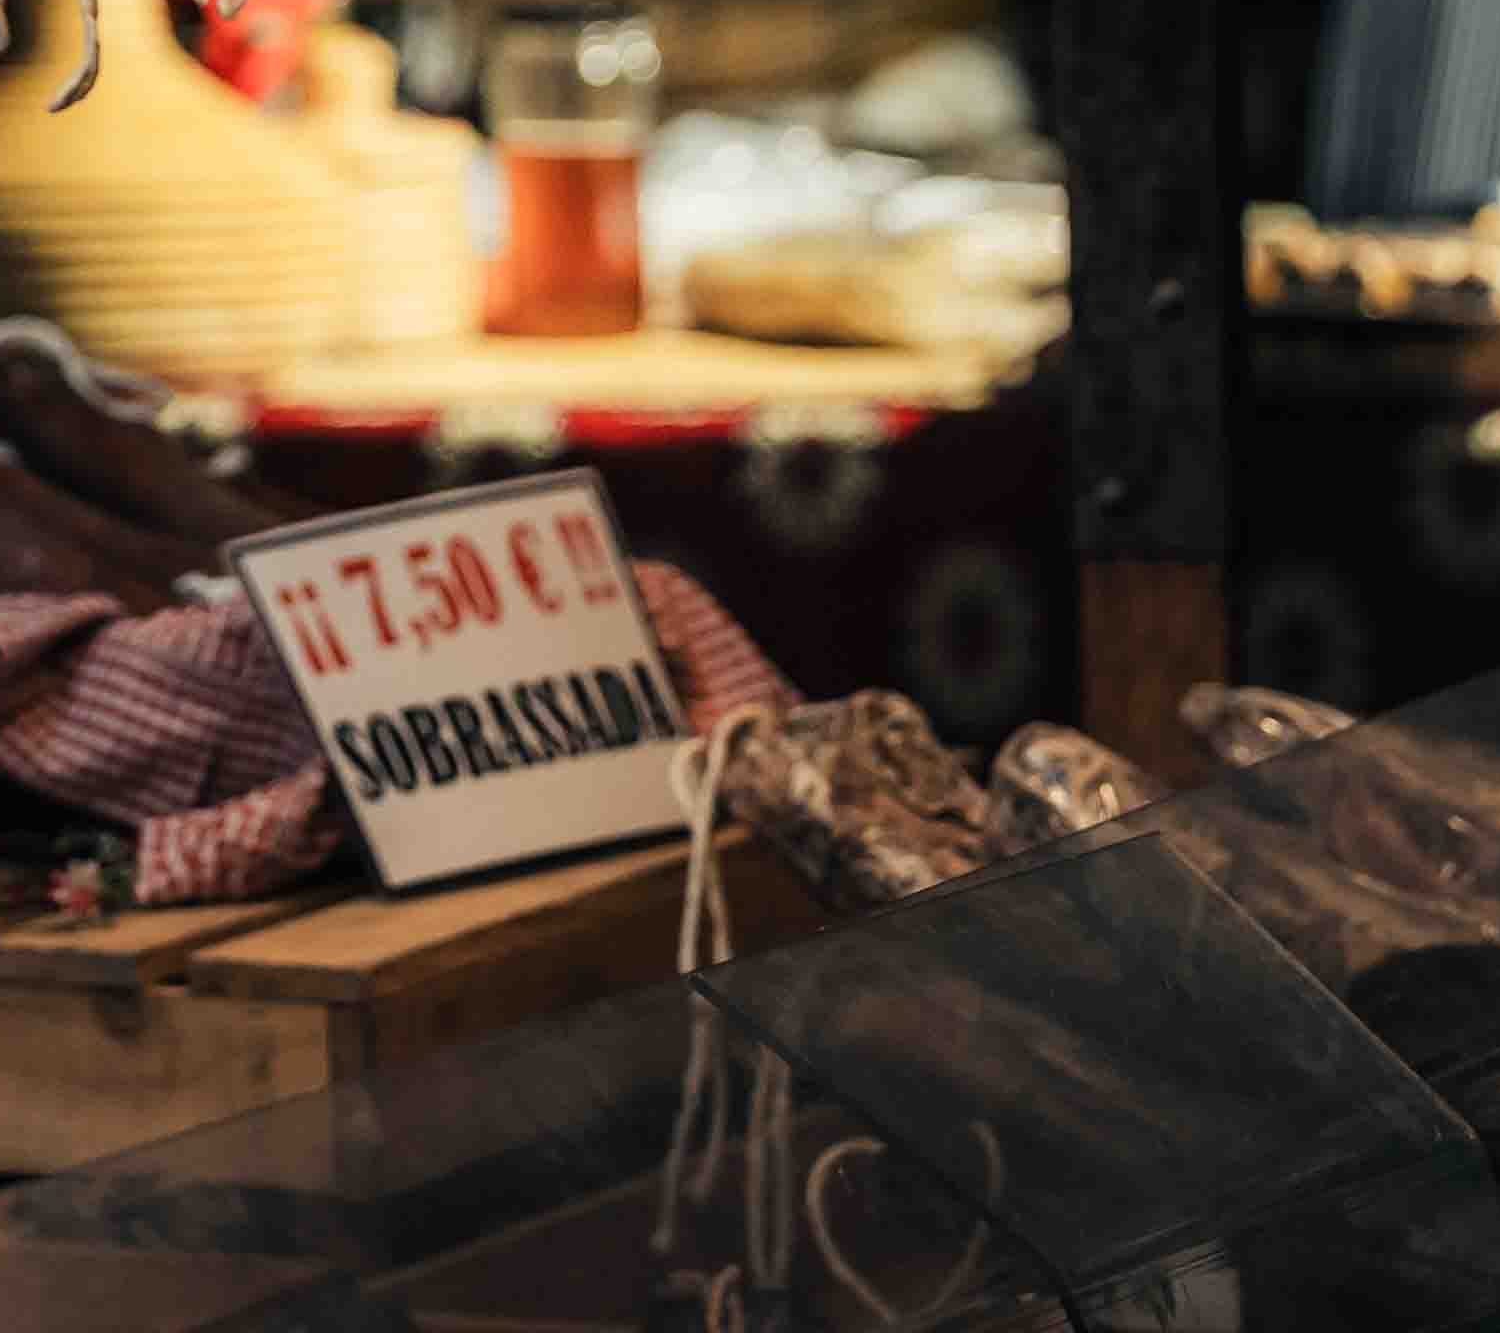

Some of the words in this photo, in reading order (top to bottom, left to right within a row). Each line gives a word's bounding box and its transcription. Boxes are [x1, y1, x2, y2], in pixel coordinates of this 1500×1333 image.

[337, 535, 503, 653] 7,50
[508, 521, 562, 614] €
[335, 663, 677, 800] SOBRASSADA
